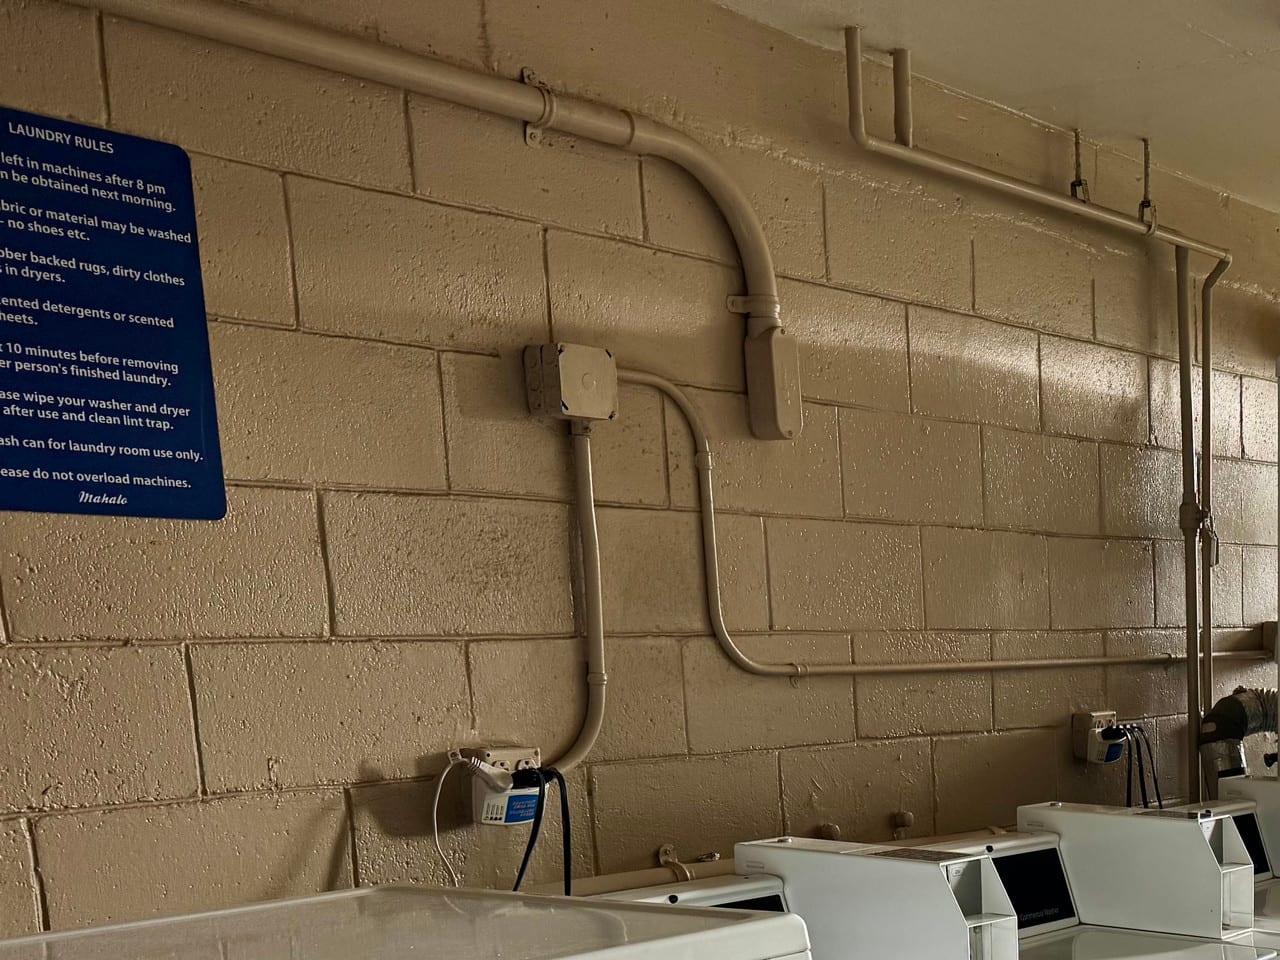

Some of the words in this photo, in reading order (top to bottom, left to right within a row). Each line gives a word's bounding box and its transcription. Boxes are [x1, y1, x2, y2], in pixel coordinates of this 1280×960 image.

[9, 121, 71, 145] LAUNDRY
[75, 135, 114, 154] RULES
[1, 152, 24, 167] left
[26, 157, 39, 170] in
[42, 163, 102, 182] machines
[105, 174, 134, 189] after
[136, 180, 144, 190] 8
[147, 184, 166, 195] pm
[11, 169, 28, 183] be
[32, 175, 88, 195] obtained
[92, 188, 119, 201] next
[122, 193, 176, 213] morning.
[0, 200, 26, 214] bric
[29, 207, 43, 217] or
[46, 208, 98, 227] material
[101, 220, 127, 235] may
[130, 222, 144, 236] be
[147, 227, 192, 243] washed
[8, 219, 25, 230] no
[28, 221, 64, 237] shoes
[67, 228, 90, 241] etc.
[5, 264, 18, 276] in
[21, 266, 66, 283] dryers.
[30, 251, 76, 269] backed
[79, 262, 109, 276] rugs,
[112, 265, 141, 281] dirty
[143, 270, 185, 286] clothes
[0, 297, 39, 310] ented
[42, 300, 111, 320] detergents
[113, 312, 126, 321] or
[128, 314, 174, 328] scented
[6, 342, 22, 354] 10
[25, 345, 77, 361] minutes
[79, 351, 119, 366] before
[122, 358, 179, 374] removing
[14, 361, 68, 376] person's
[70, 366, 120, 381] finished
[122, 371, 171, 388] laundry.
[3, 404, 34, 417] after
[37, 410, 59, 419] use
[62, 409, 86, 421] and
[88, 412, 121, 424] clean
[123, 415, 144, 427] lint
[146, 419, 174, 432] trap.
[22, 392, 54, 405] wipe
[57, 395, 86, 408] your
[88, 398, 132, 411] washer
[134, 403, 157, 416] and
[159, 405, 191, 418] dryer
[22, 439, 45, 449] can
[48, 438, 66, 450] for
[69, 440, 116, 457] laundry
[119, 447, 150, 457] room
[153, 448, 173, 458] use
[175, 449, 204, 462] only.
[33, 468, 50, 480] do
[52, 471, 74, 481] not
[77, 472, 130, 485] overload
[133, 476, 192, 488] machines.
[79, 491, 128, 505] Mahalo
